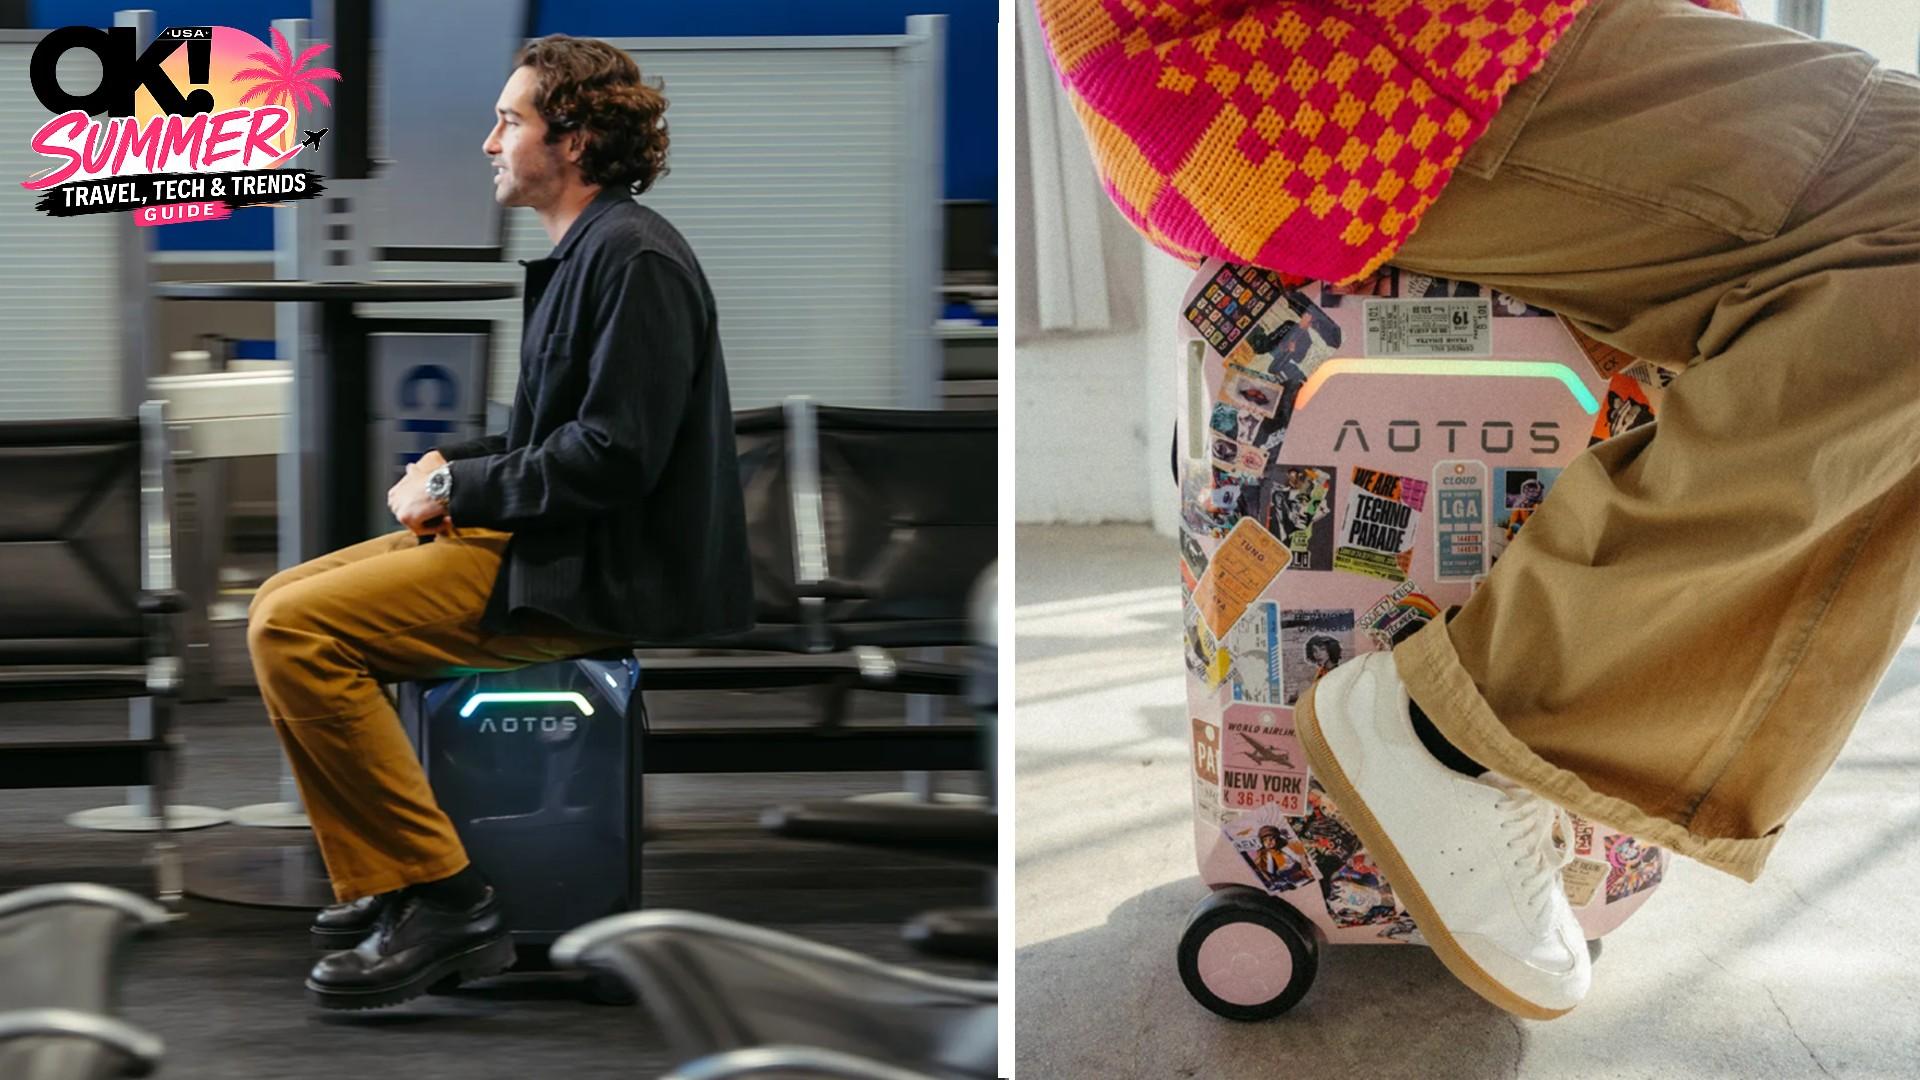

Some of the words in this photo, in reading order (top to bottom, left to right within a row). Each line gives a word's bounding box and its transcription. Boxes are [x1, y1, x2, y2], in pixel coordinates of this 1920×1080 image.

[1452, 311, 1469, 325] 19
[1336, 420, 1561, 454] AOTOS
[1354, 468, 1370, 491] WE
[1372, 474, 1400, 498] ARE
[1442, 476, 1477, 485] CLOUD
[1356, 494, 1412, 529] TECHNO
[1442, 499, 1478, 519] LGA
[1349, 519, 1406, 553] PARADE
[1359, 597, 1392, 628] SOCIETY
[479, 716, 578, 733] AOTOS
[1228, 723, 1260, 734] WORLD
[1224, 771, 1260, 791] NEW
[1263, 775, 1302, 794] YORK
